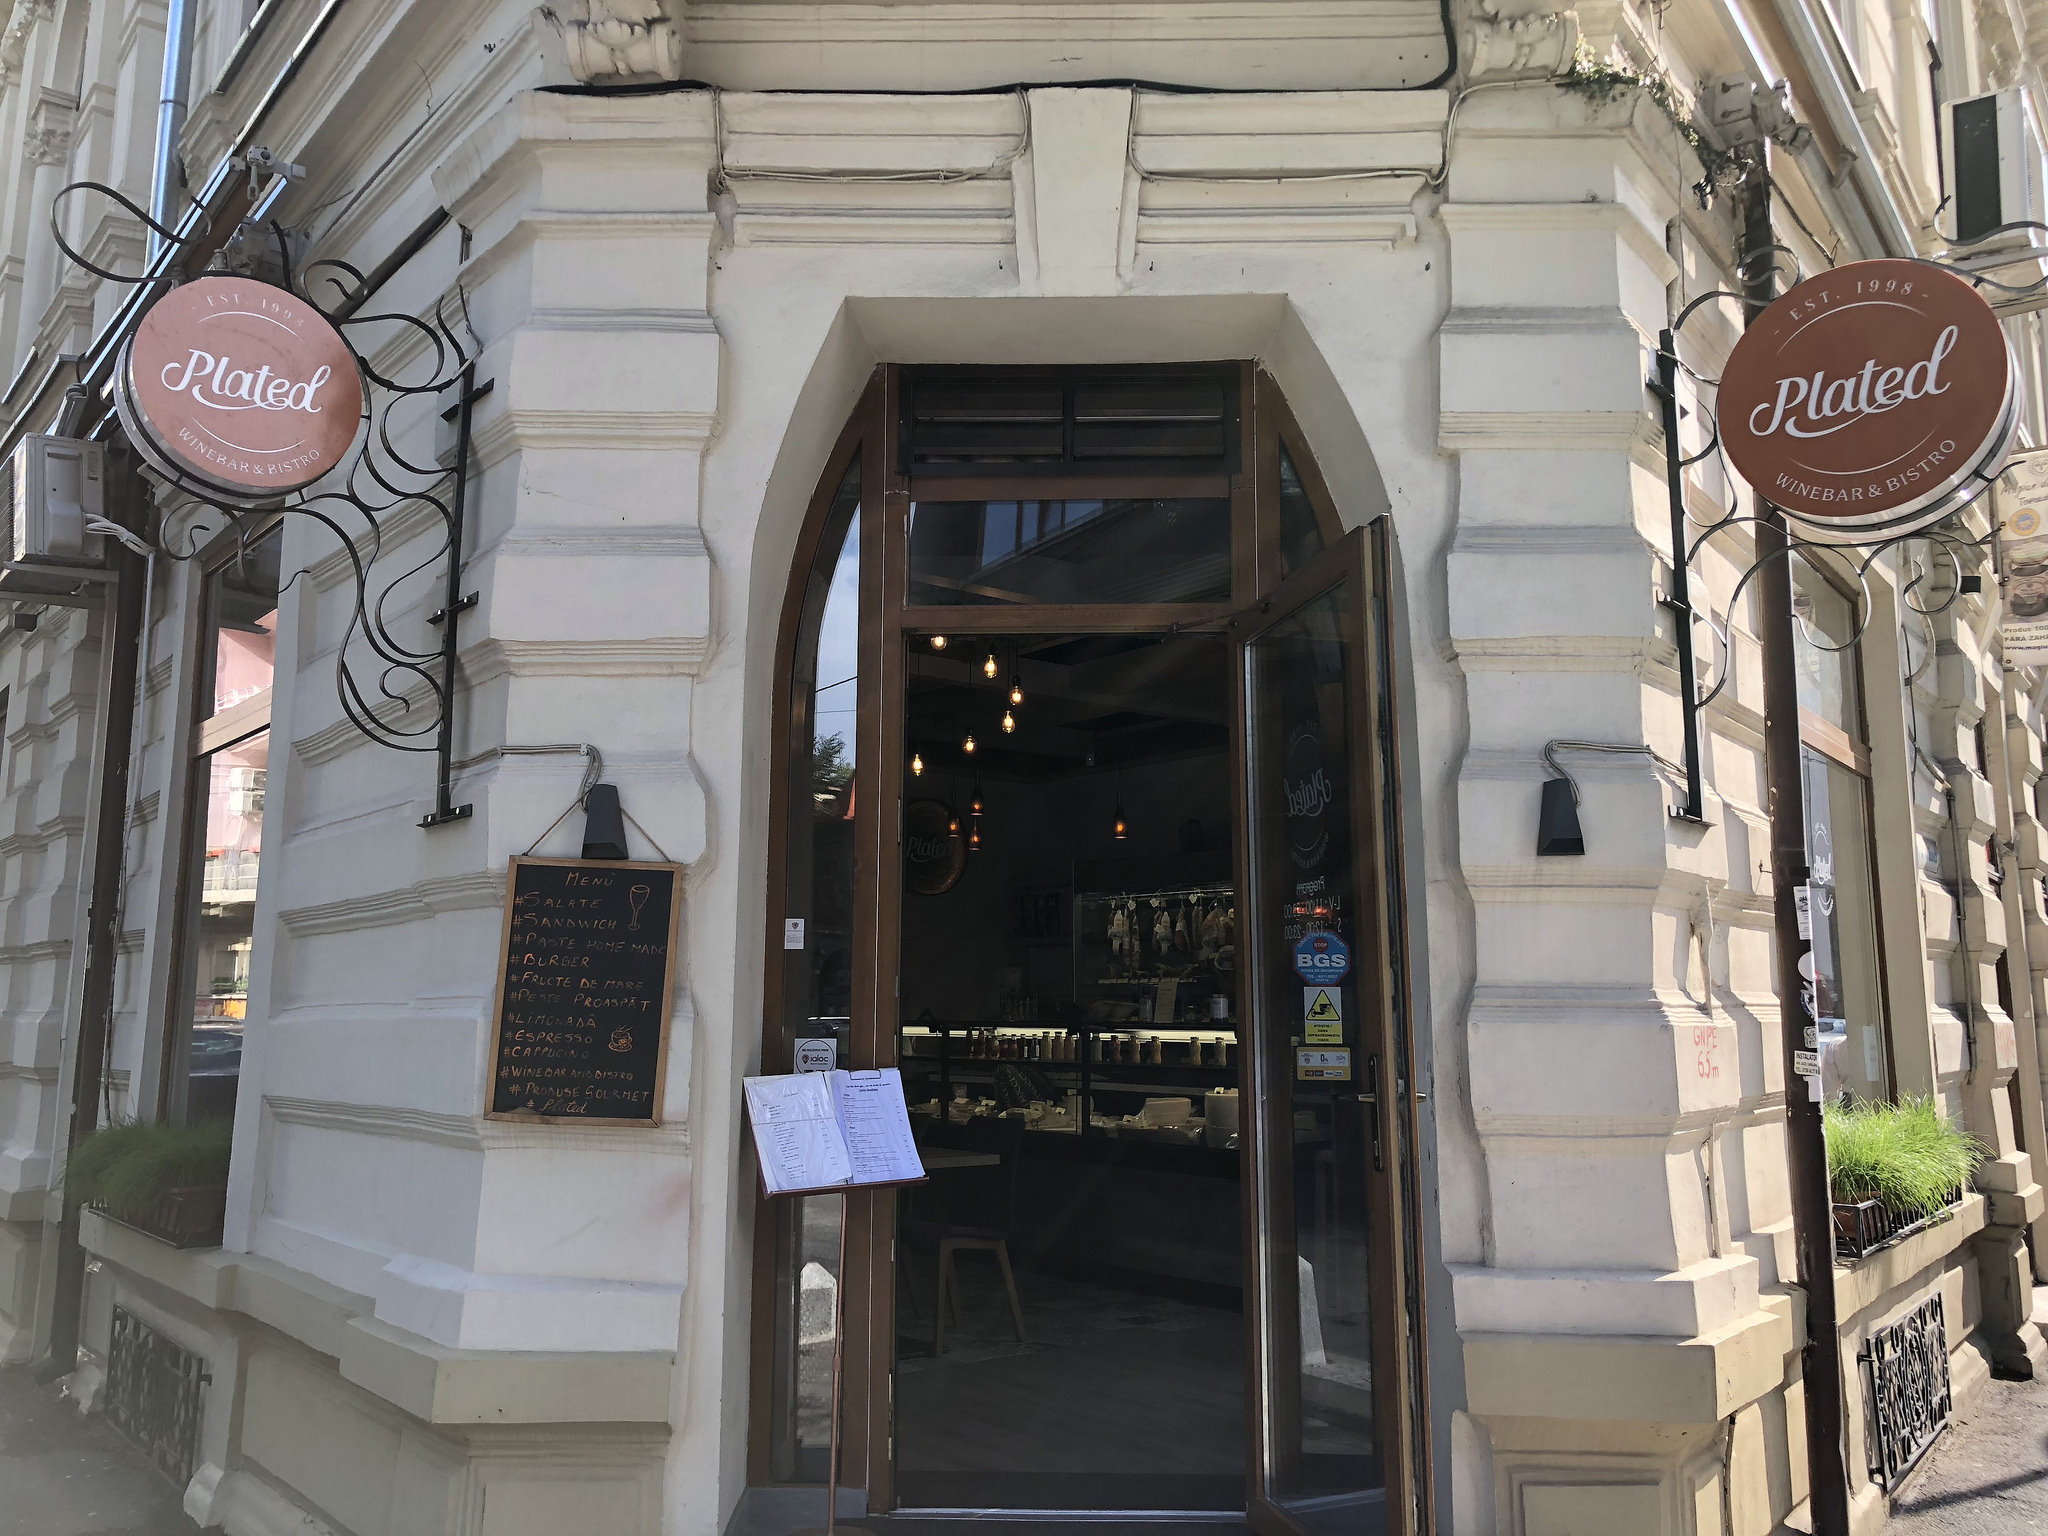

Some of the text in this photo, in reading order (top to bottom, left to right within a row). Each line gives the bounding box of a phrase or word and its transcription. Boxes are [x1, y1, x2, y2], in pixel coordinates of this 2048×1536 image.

[1856, 278, 1914, 296] 1998
[261, 298, 304, 327] 1998
[160, 348, 332, 413] Plated
[1749, 325, 1959, 438] Plated
[178, 426, 321, 475] WINEBAR & BISTRO
[1775, 438, 1956, 502] WINEBAR & BISTRO
[587, 939, 626, 952] HOME
[1297, 953, 1346, 968] BGS
[580, 977, 598, 989] DE
[604, 979, 645, 991] MARE
[585, 1084, 650, 1102] GOURMET
